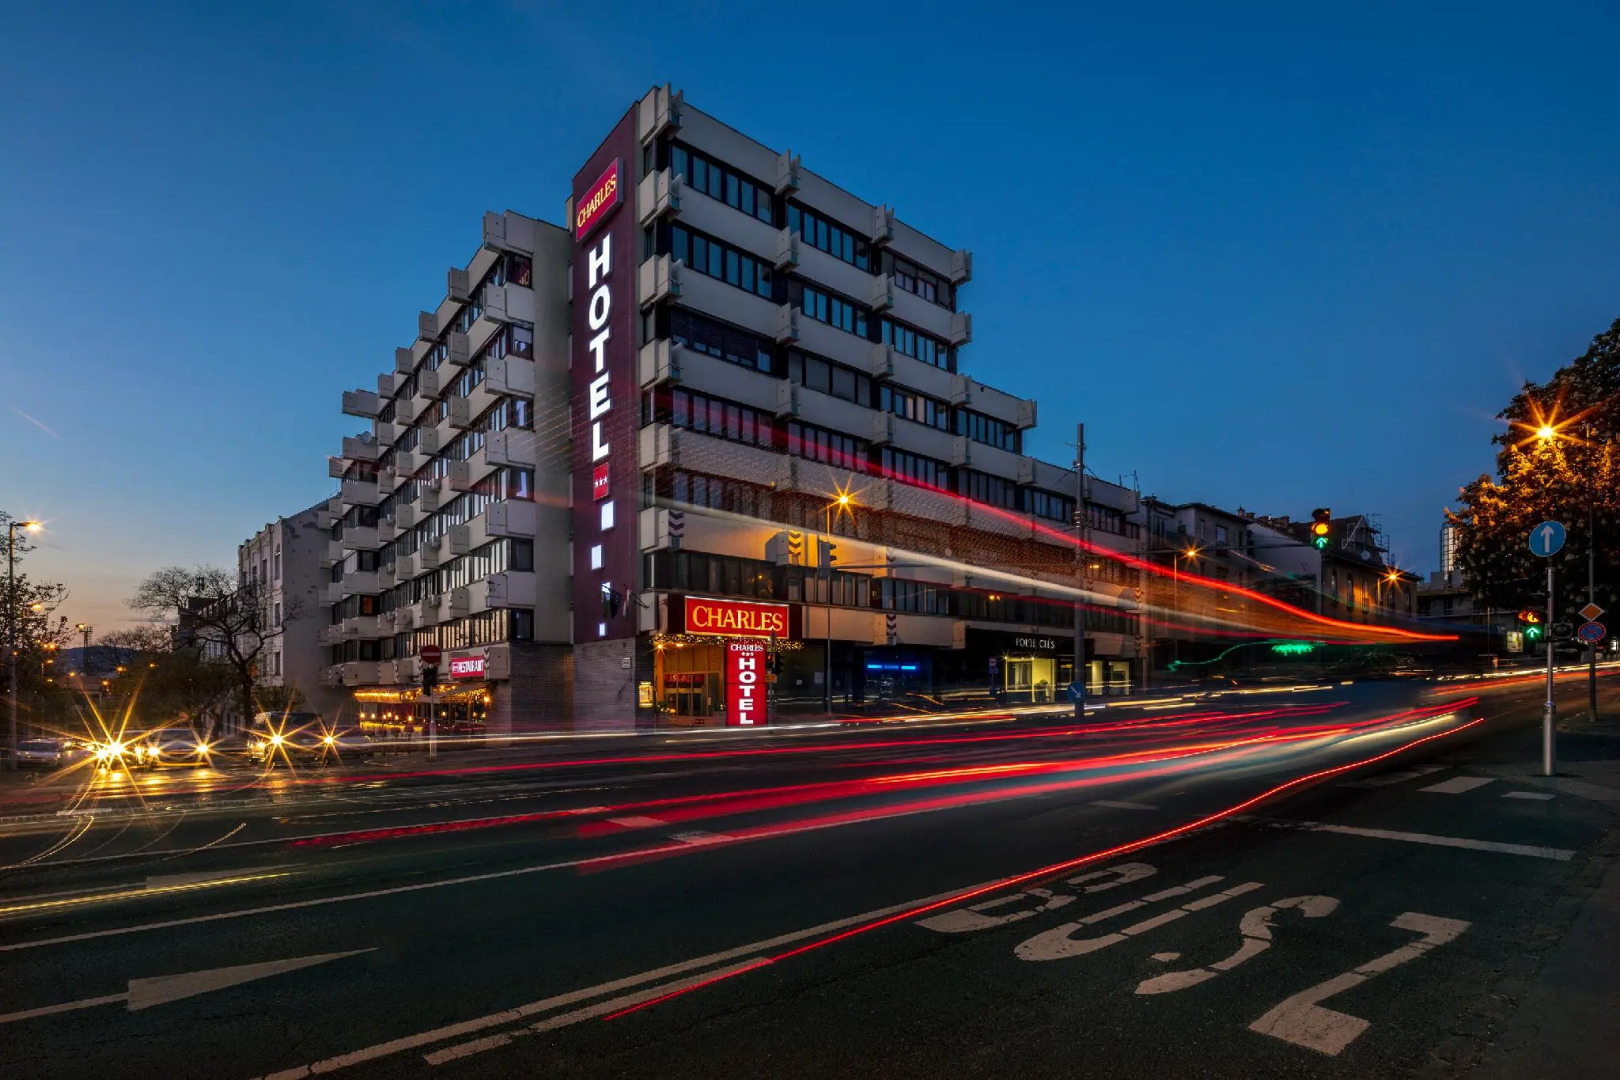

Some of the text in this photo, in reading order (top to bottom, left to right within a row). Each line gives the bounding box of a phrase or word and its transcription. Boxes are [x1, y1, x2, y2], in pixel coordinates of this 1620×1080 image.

[577, 173, 617, 228] CHARLES
[588, 231, 612, 463] HOTEL
[692, 605, 783, 632] CHARLES
[730, 643, 764, 652] CHARLES
[738, 657, 757, 725] HOTEL
[914, 863, 1473, 1057] BUSZ
